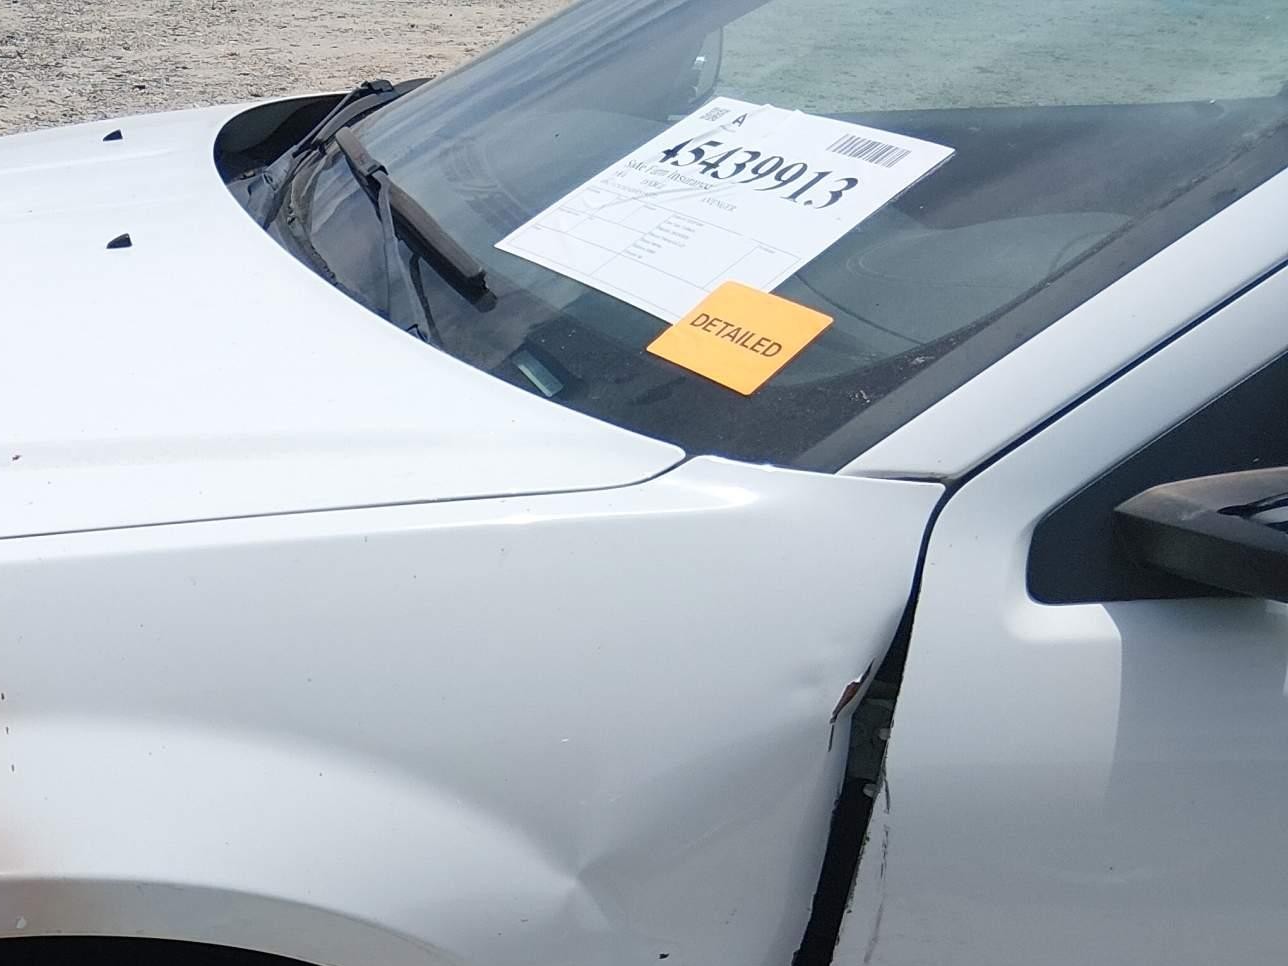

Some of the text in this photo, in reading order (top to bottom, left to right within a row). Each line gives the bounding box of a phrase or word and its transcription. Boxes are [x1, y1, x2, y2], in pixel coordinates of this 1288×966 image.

[732, 113, 748, 127] A
[659, 138, 859, 210] 45439913
[689, 312, 783, 358] DETAILED
